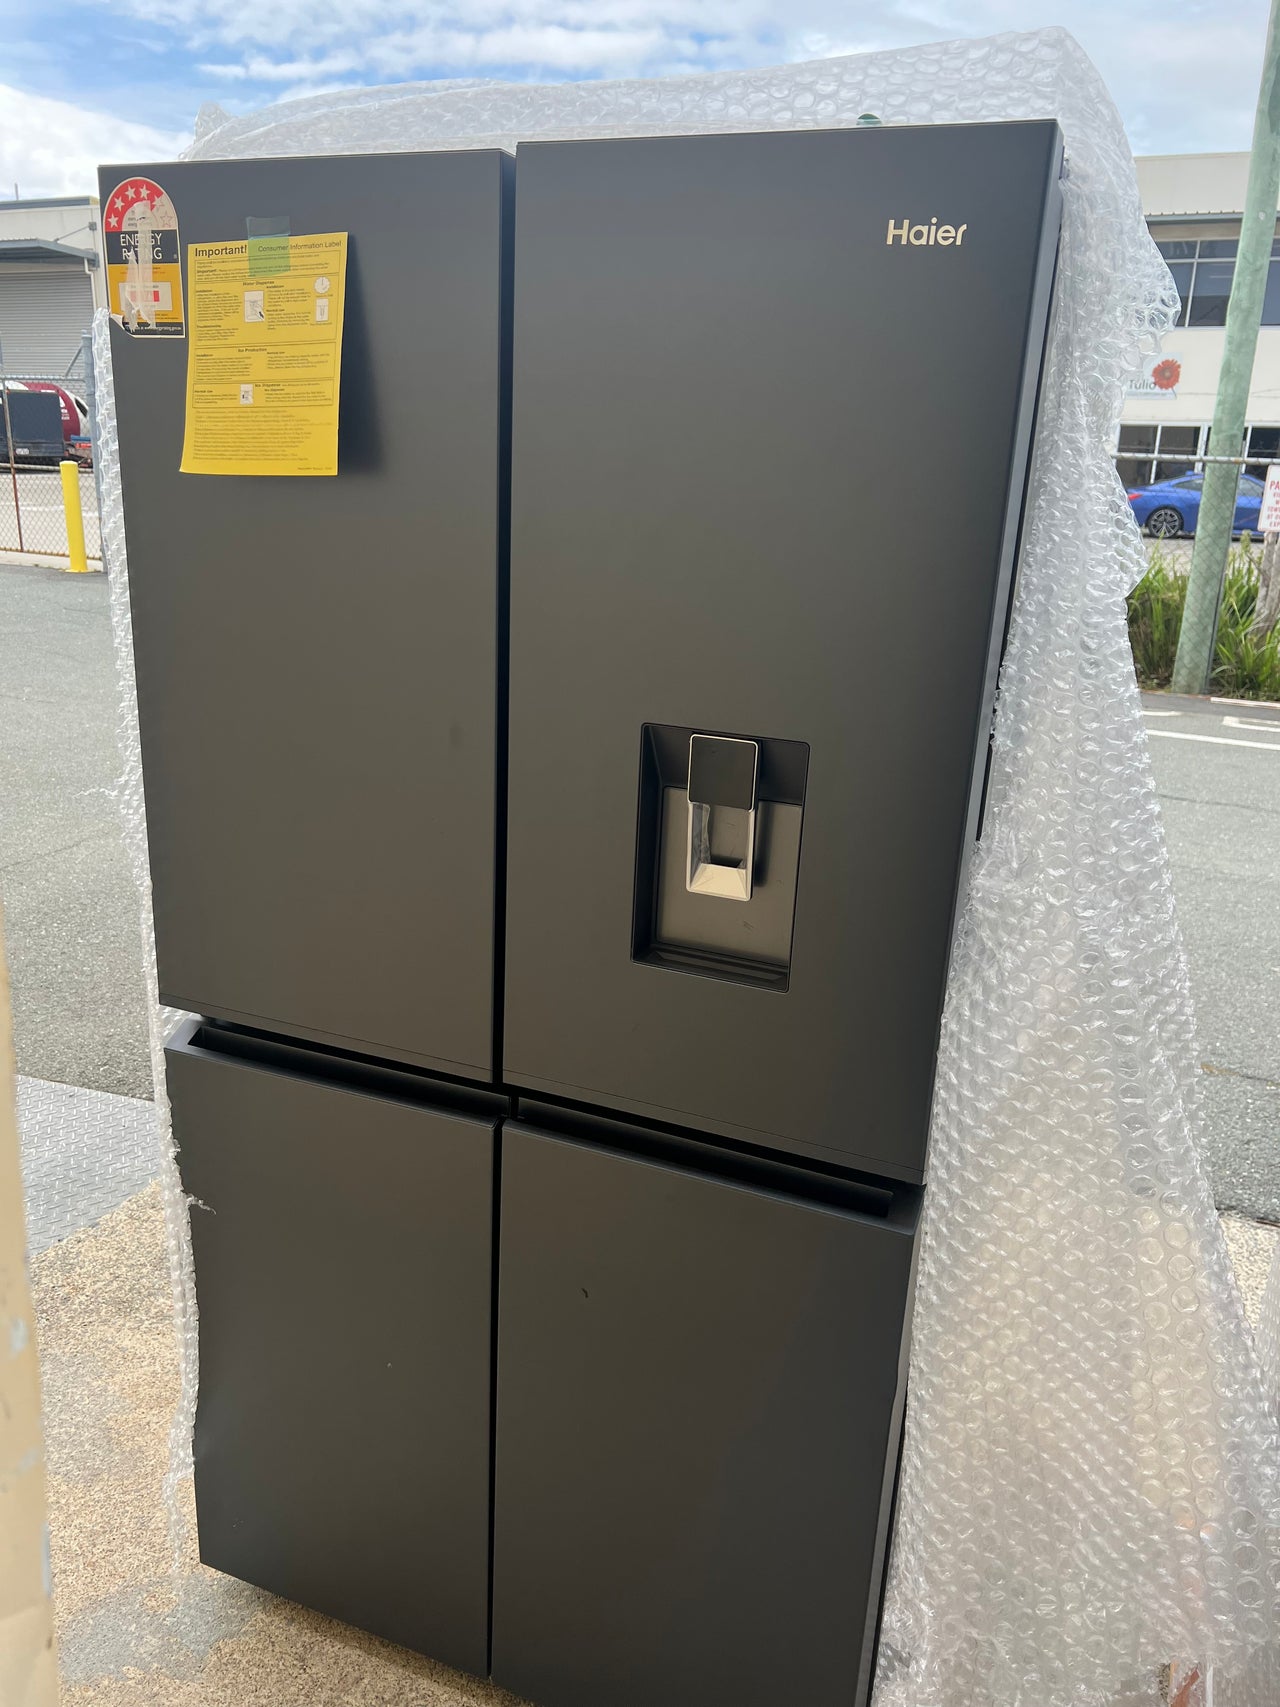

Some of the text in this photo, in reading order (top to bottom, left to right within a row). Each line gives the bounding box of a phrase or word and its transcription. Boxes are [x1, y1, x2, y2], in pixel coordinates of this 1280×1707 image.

[120, 232, 162, 246] ENEGY
[886, 217, 967, 246] Haier
[195, 244, 247, 258] Important!
[290, 242, 324, 250] Information
[324, 240, 342, 248] Label
